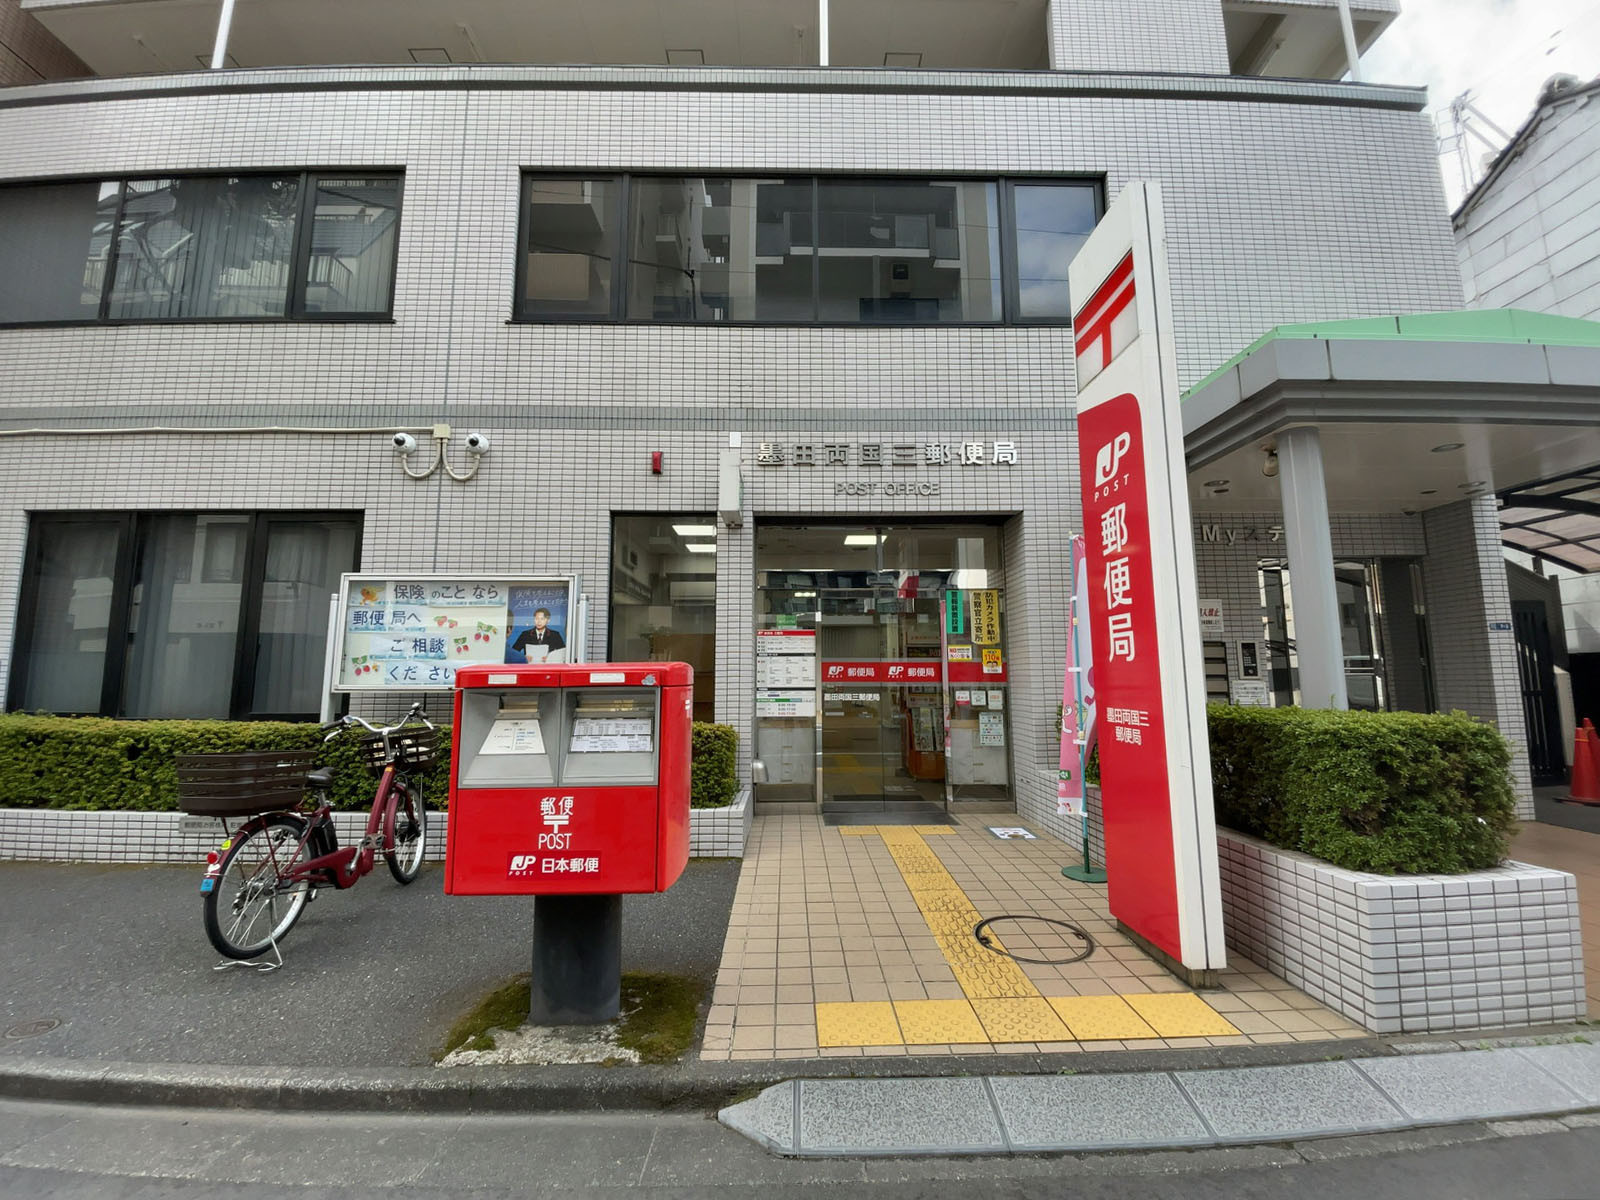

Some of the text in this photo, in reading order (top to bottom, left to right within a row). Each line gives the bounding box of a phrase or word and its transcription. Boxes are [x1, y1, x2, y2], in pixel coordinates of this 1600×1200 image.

[757, 441, 1018, 466] 墨田両国三郵便局
[834, 482, 941, 496] POST OFFICE
[1094, 473, 1130, 502] POST
[1100, 502, 1135, 663] 郵便局
[973, 592, 983, 642] 警察官立寄所
[985, 592, 995, 642] 防犯カメラ作動中
[847, 667, 875, 677] 郵便局
[907, 667, 935, 677] 郵便局
[1106, 706, 1150, 728] 墨田両国三
[1115, 726, 1142, 746] 郵便局
[540, 796, 574, 816] 郵便
[538, 833, 572, 849] POST
[541, 858, 599, 873] 日本郵便
